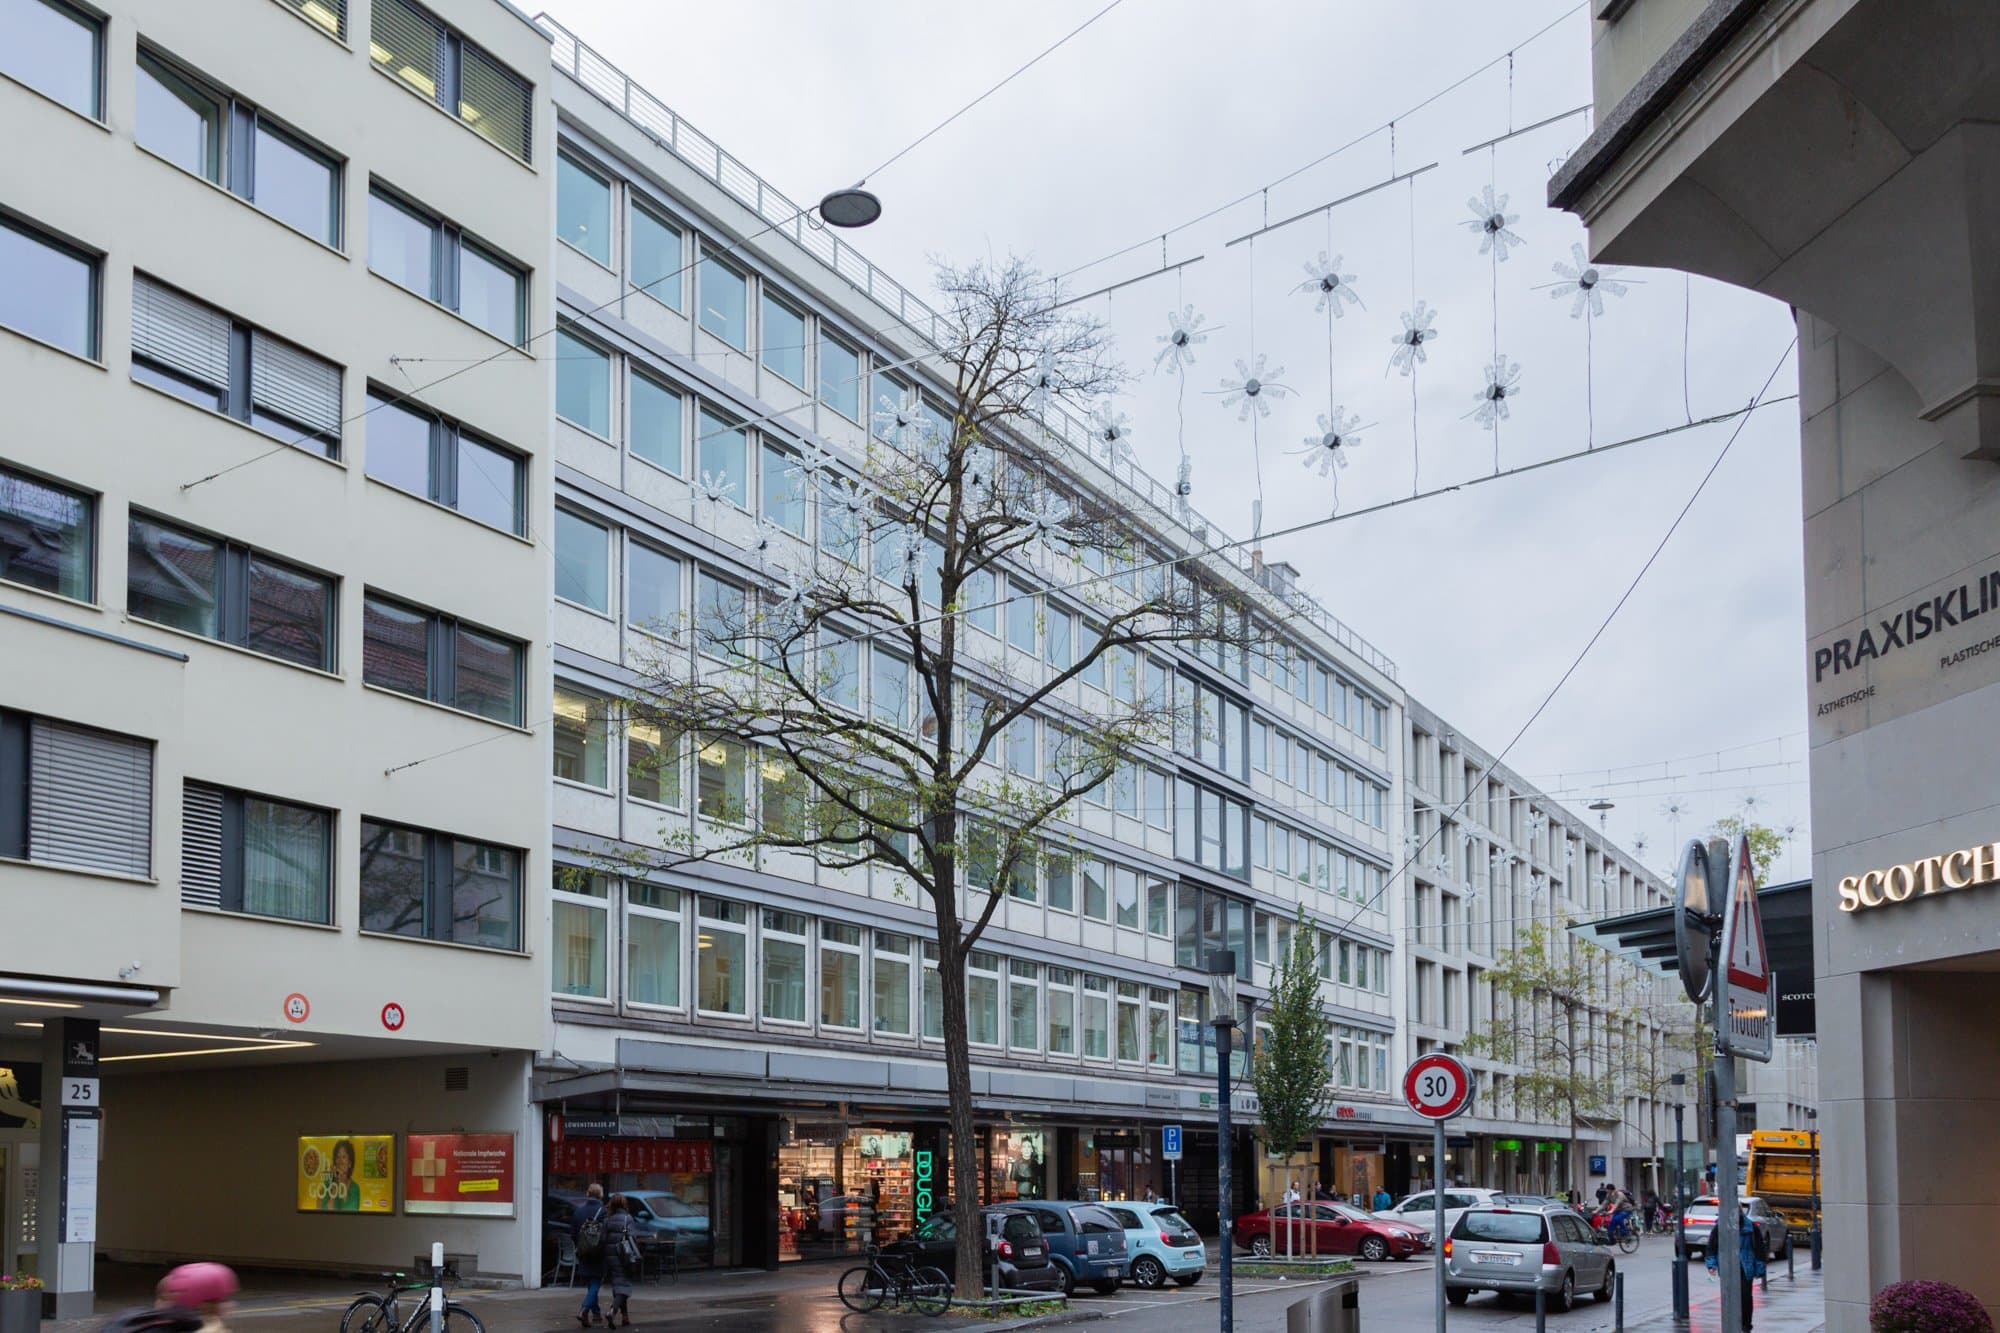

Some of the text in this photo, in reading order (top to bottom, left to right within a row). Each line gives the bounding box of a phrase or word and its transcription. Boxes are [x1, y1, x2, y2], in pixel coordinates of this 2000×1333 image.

[1940, 634, 2000, 669] PLASTISCHE
[1817, 685, 1876, 717] ÄSTHETISCHE
[1838, 842, 2000, 912] SCOTCH
[1729, 998, 1766, 1040] Trottoir
[71, 1084, 91, 1100] 25
[1424, 1076, 1447, 1098] 30
[1168, 1128, 1176, 1141] P
